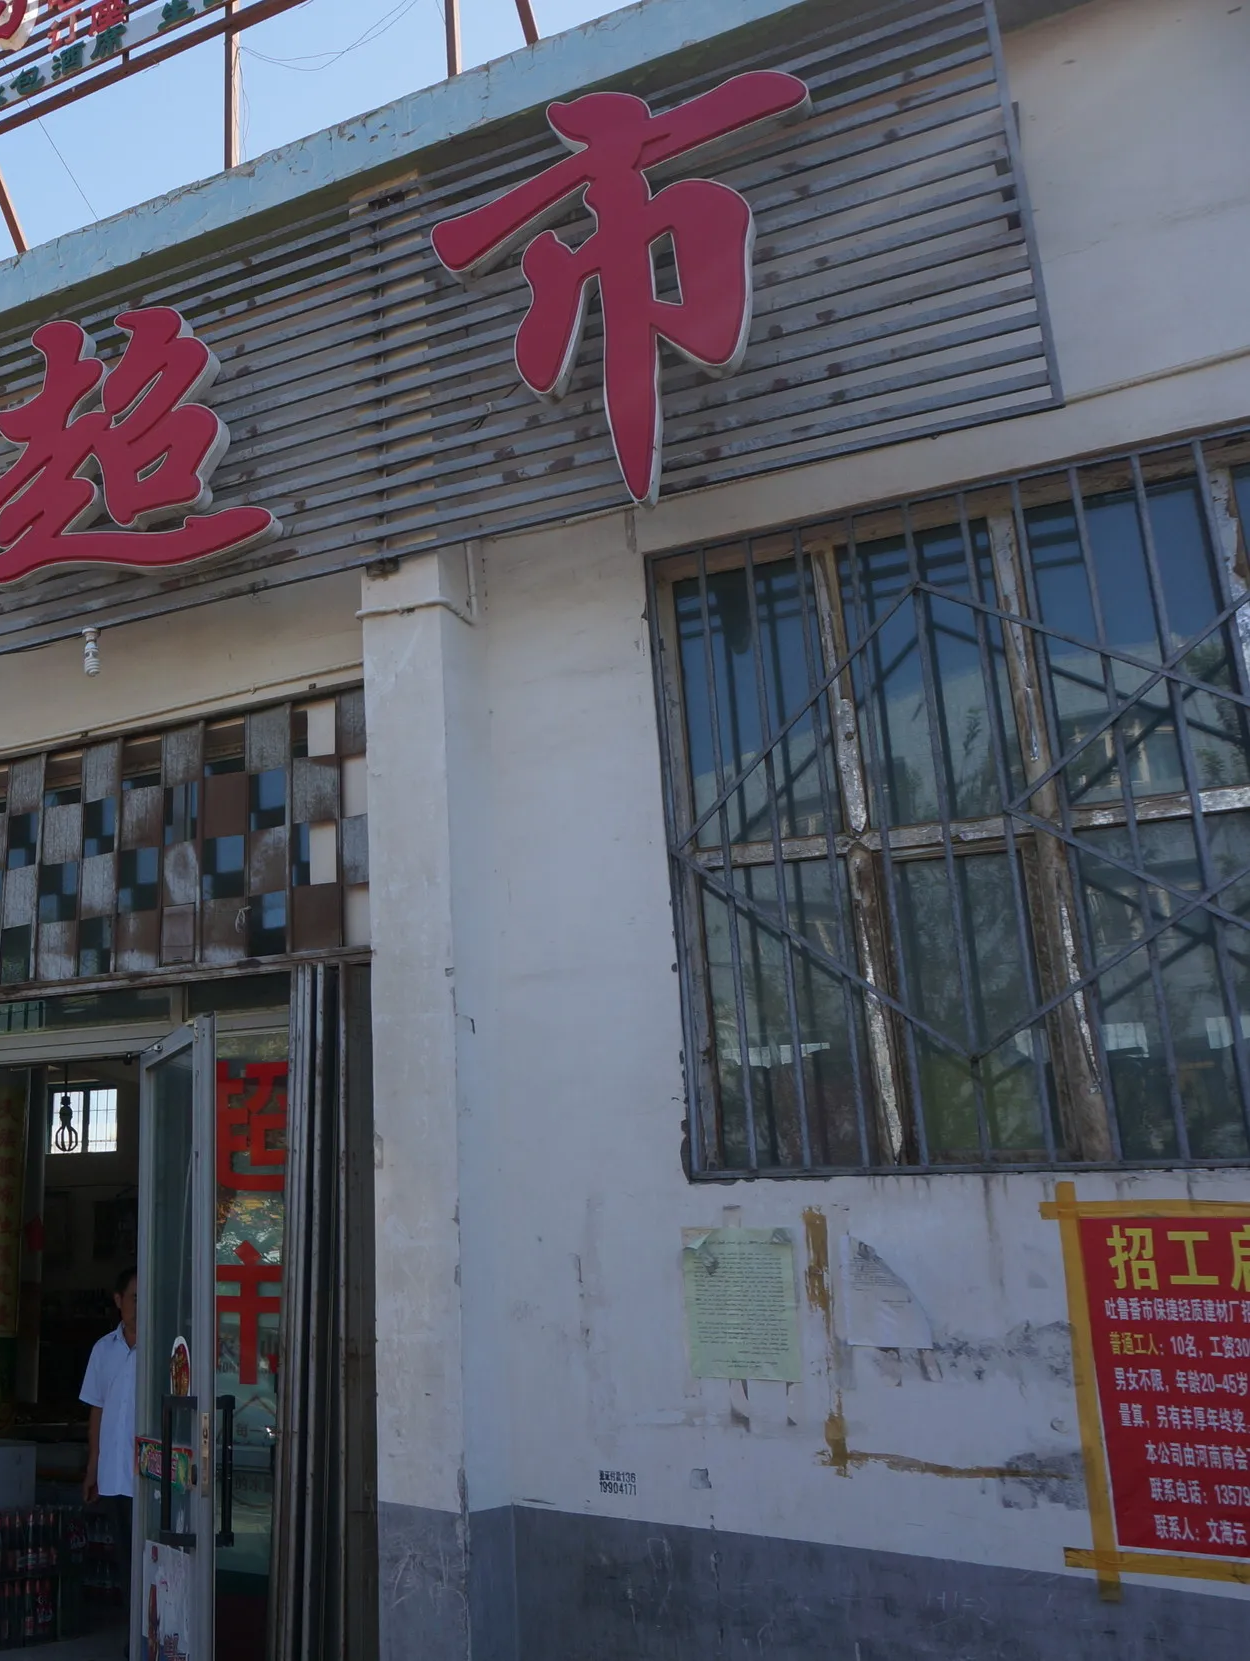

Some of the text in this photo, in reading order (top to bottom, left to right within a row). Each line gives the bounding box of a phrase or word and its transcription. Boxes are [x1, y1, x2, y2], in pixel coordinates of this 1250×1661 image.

[1145, 1440, 1250, 1470] 本公司由河南商会
